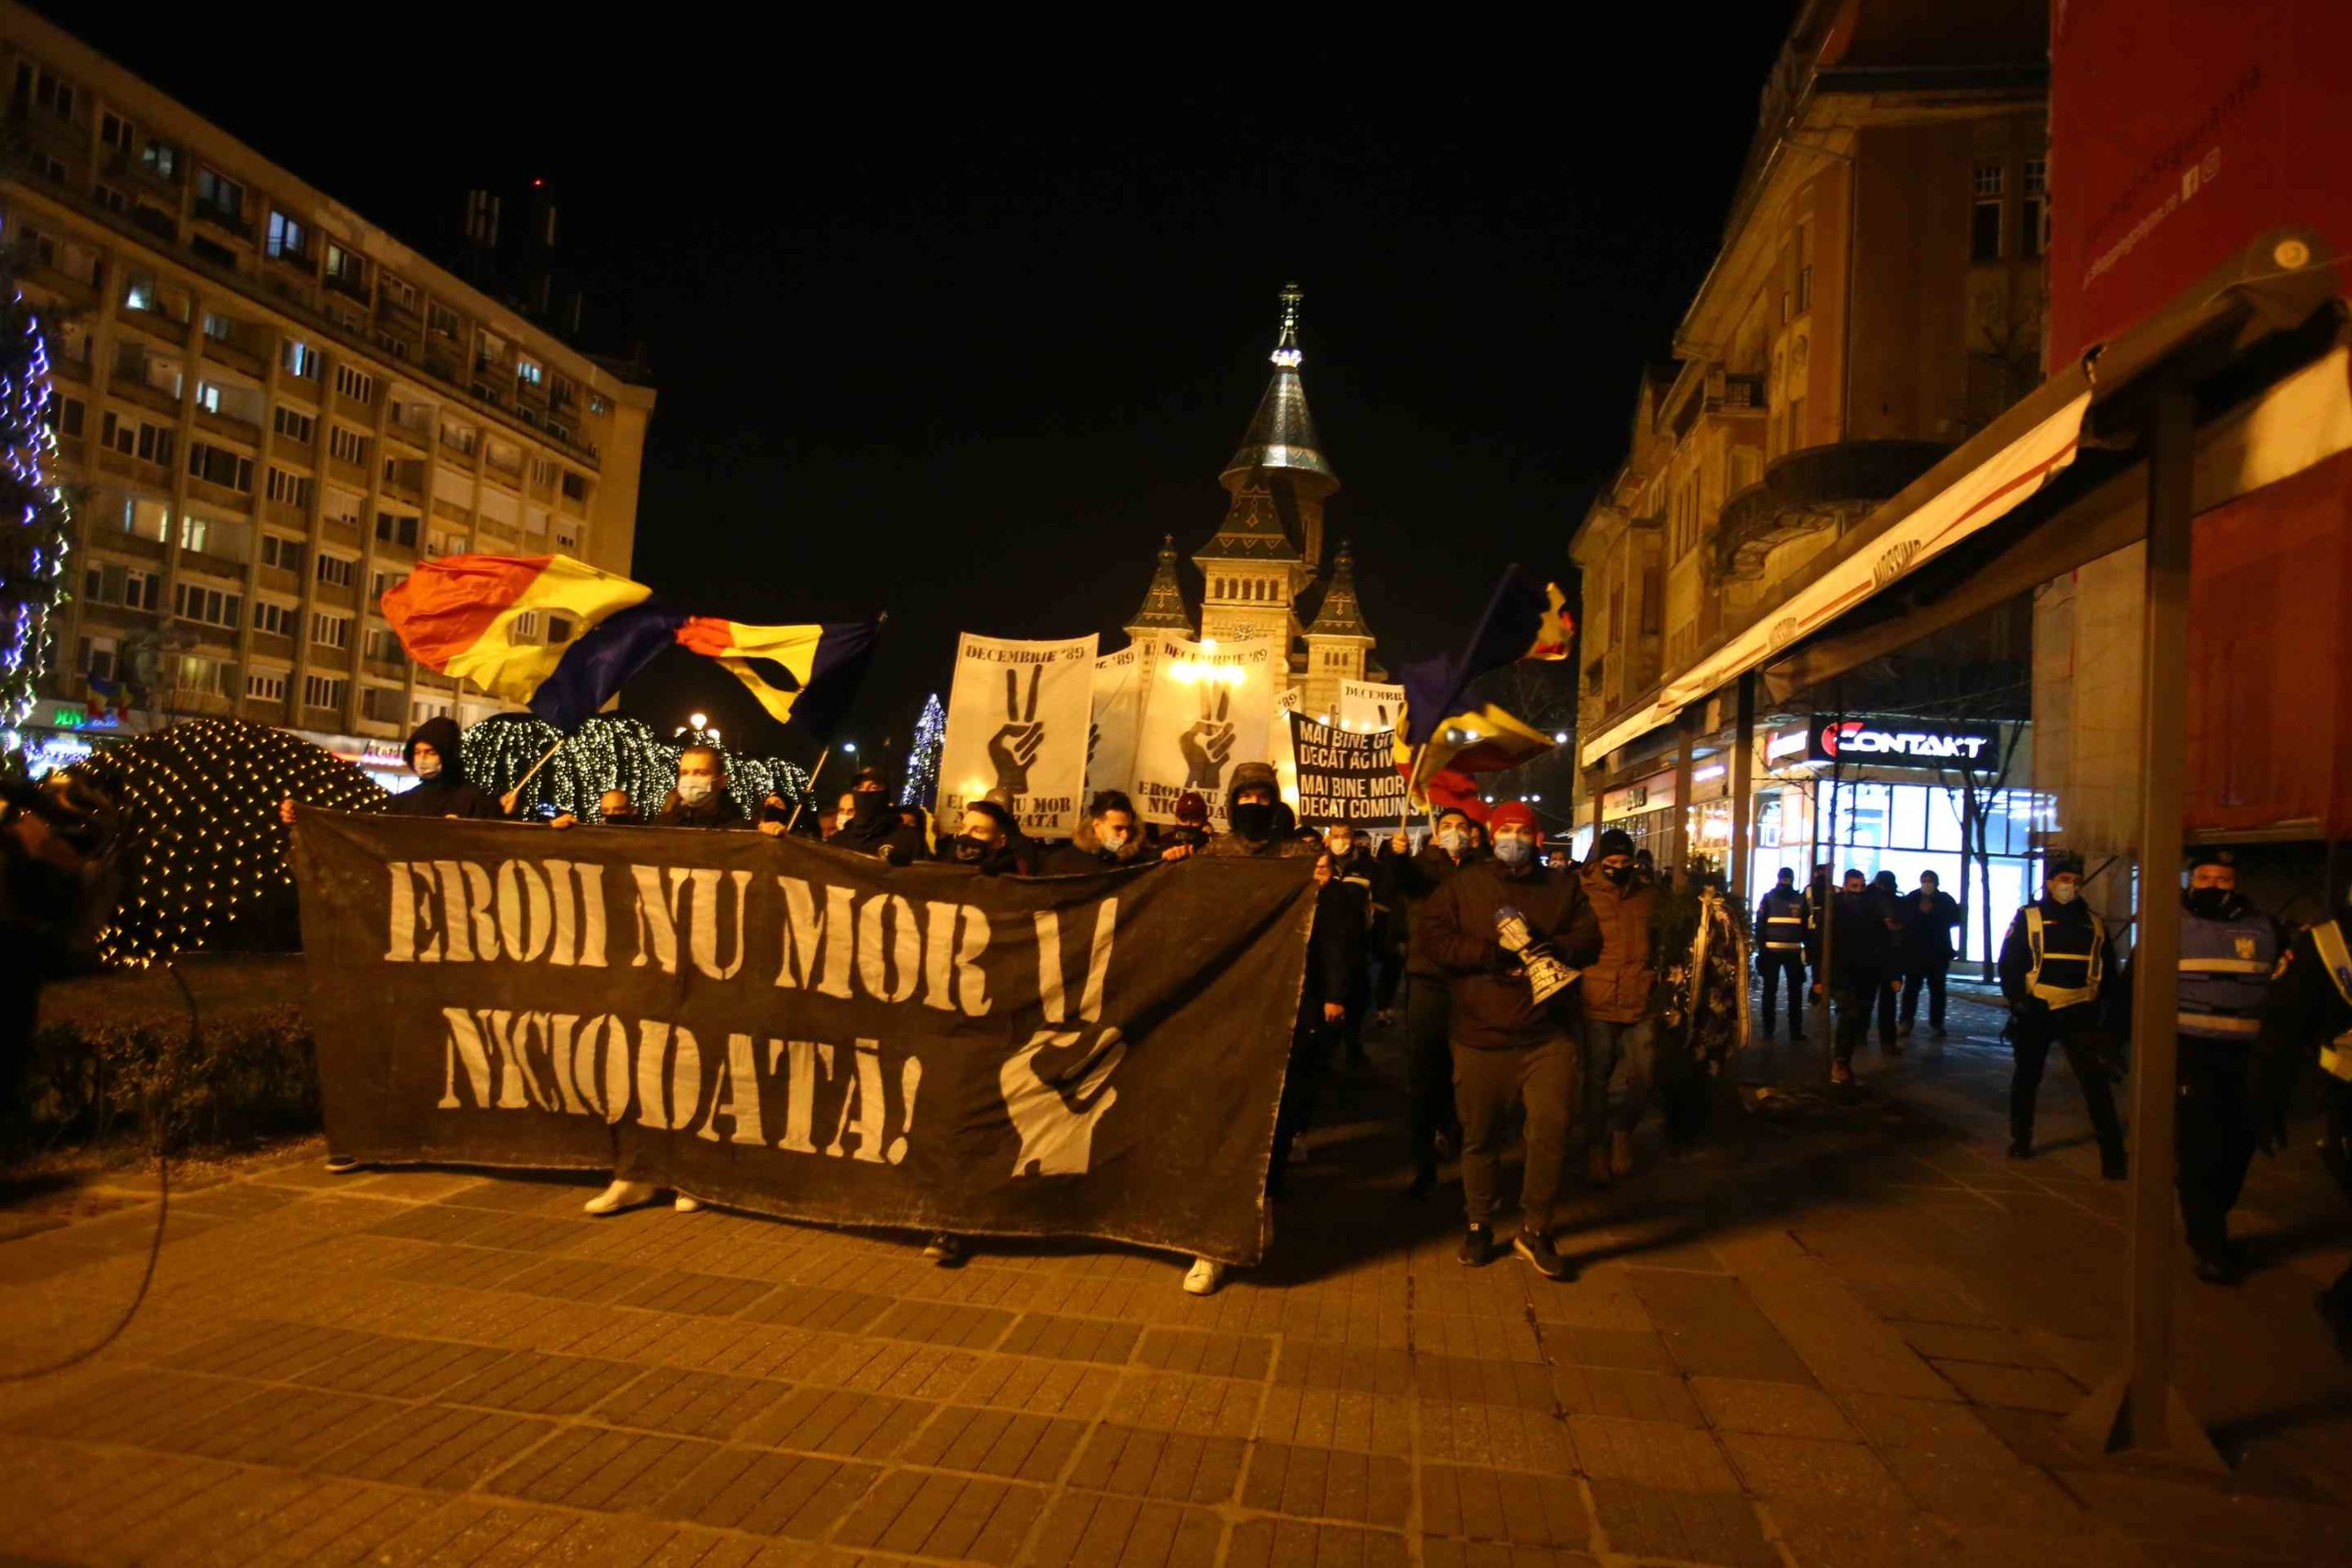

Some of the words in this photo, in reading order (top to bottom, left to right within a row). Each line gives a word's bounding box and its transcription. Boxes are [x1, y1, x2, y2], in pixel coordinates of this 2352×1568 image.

[966, 645, 1057, 663] DECEMBRIE
[1061, 646, 1085, 660] '89
[1300, 720, 1329, 746] MAI
[1332, 730, 1369, 750] BINE
[1350, 748, 1395, 770] ACTIV
[1300, 774, 1329, 795] MAI
[1332, 777, 1367, 798] BINE
[1371, 775, 1406, 797] MOR
[1033, 797, 1071, 813] MOR
[1350, 795, 1427, 818] COMUNS
[384, 859, 608, 967] EROII
[631, 864, 752, 981] NU
[775, 875, 992, 1017] MOR
